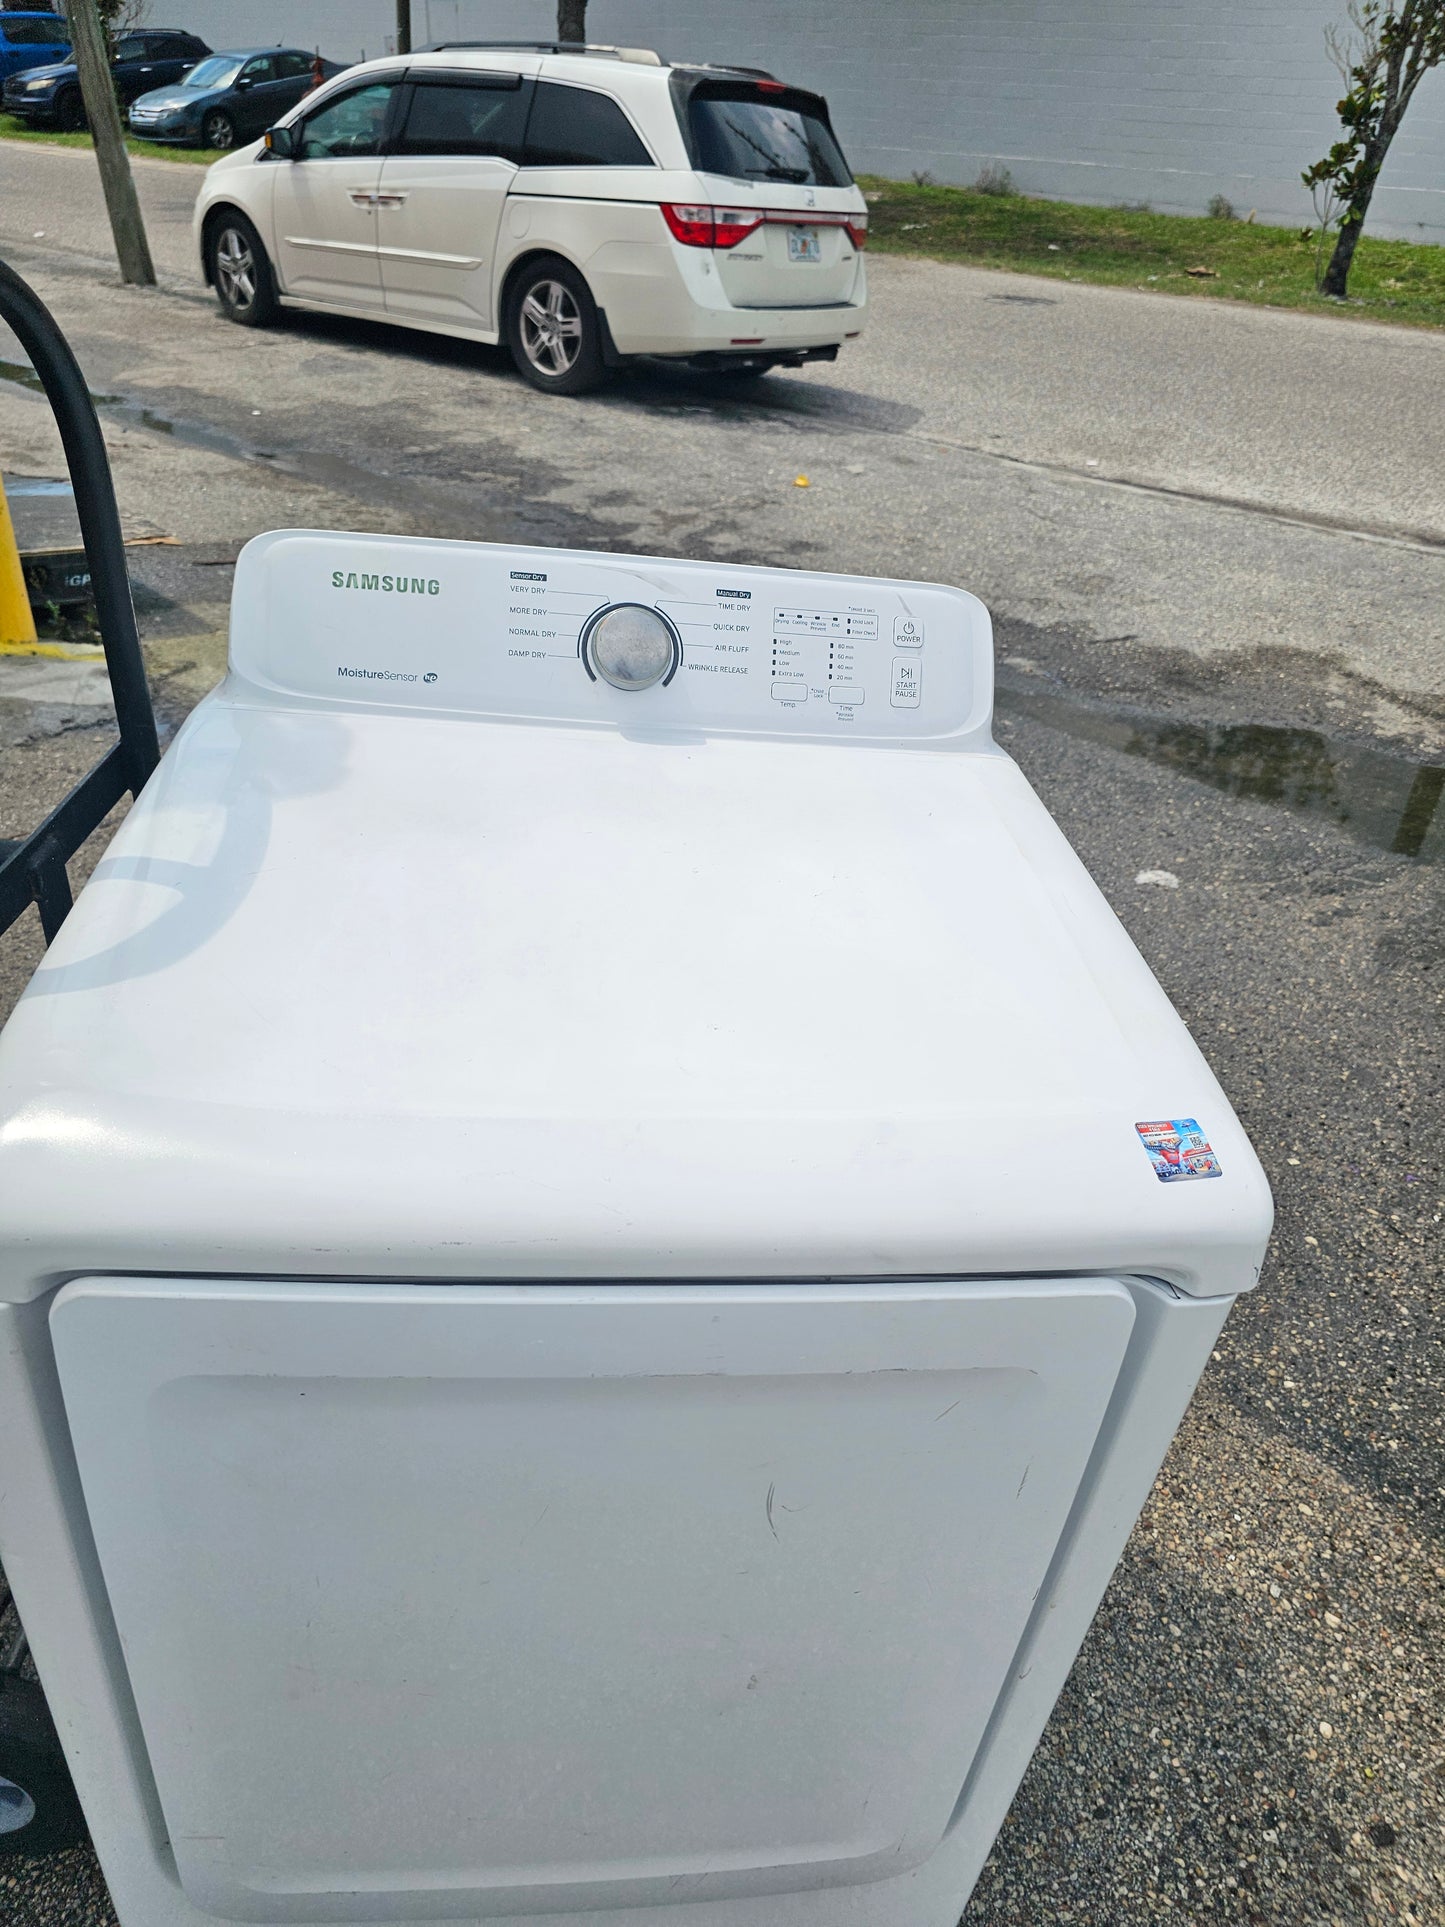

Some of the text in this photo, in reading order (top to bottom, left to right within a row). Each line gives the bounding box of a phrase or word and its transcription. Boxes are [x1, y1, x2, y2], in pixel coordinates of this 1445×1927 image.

[511, 571, 544, 581] Sensor Dry
[331, 571, 440, 596] SAMSUNG
[510, 585, 530, 593] VERY
[717, 589, 751, 599] Manual Dry
[509, 606, 548, 616] MORE DRY
[718, 602, 751, 612] TIME DRY
[713, 623, 735, 631] QUICK
[509, 627, 557, 638] NORMAL DRY
[896, 635, 921, 643] POWER
[714, 644, 750, 653] AIR FLUFF
[508, 649, 547, 659] DAMP DRY
[688, 663, 749, 675] WRINKLE RELEASE
[337, 666, 418, 683] MoistureSensor
[896, 681, 917, 689] START
[895, 690, 917, 698] PAUSE
